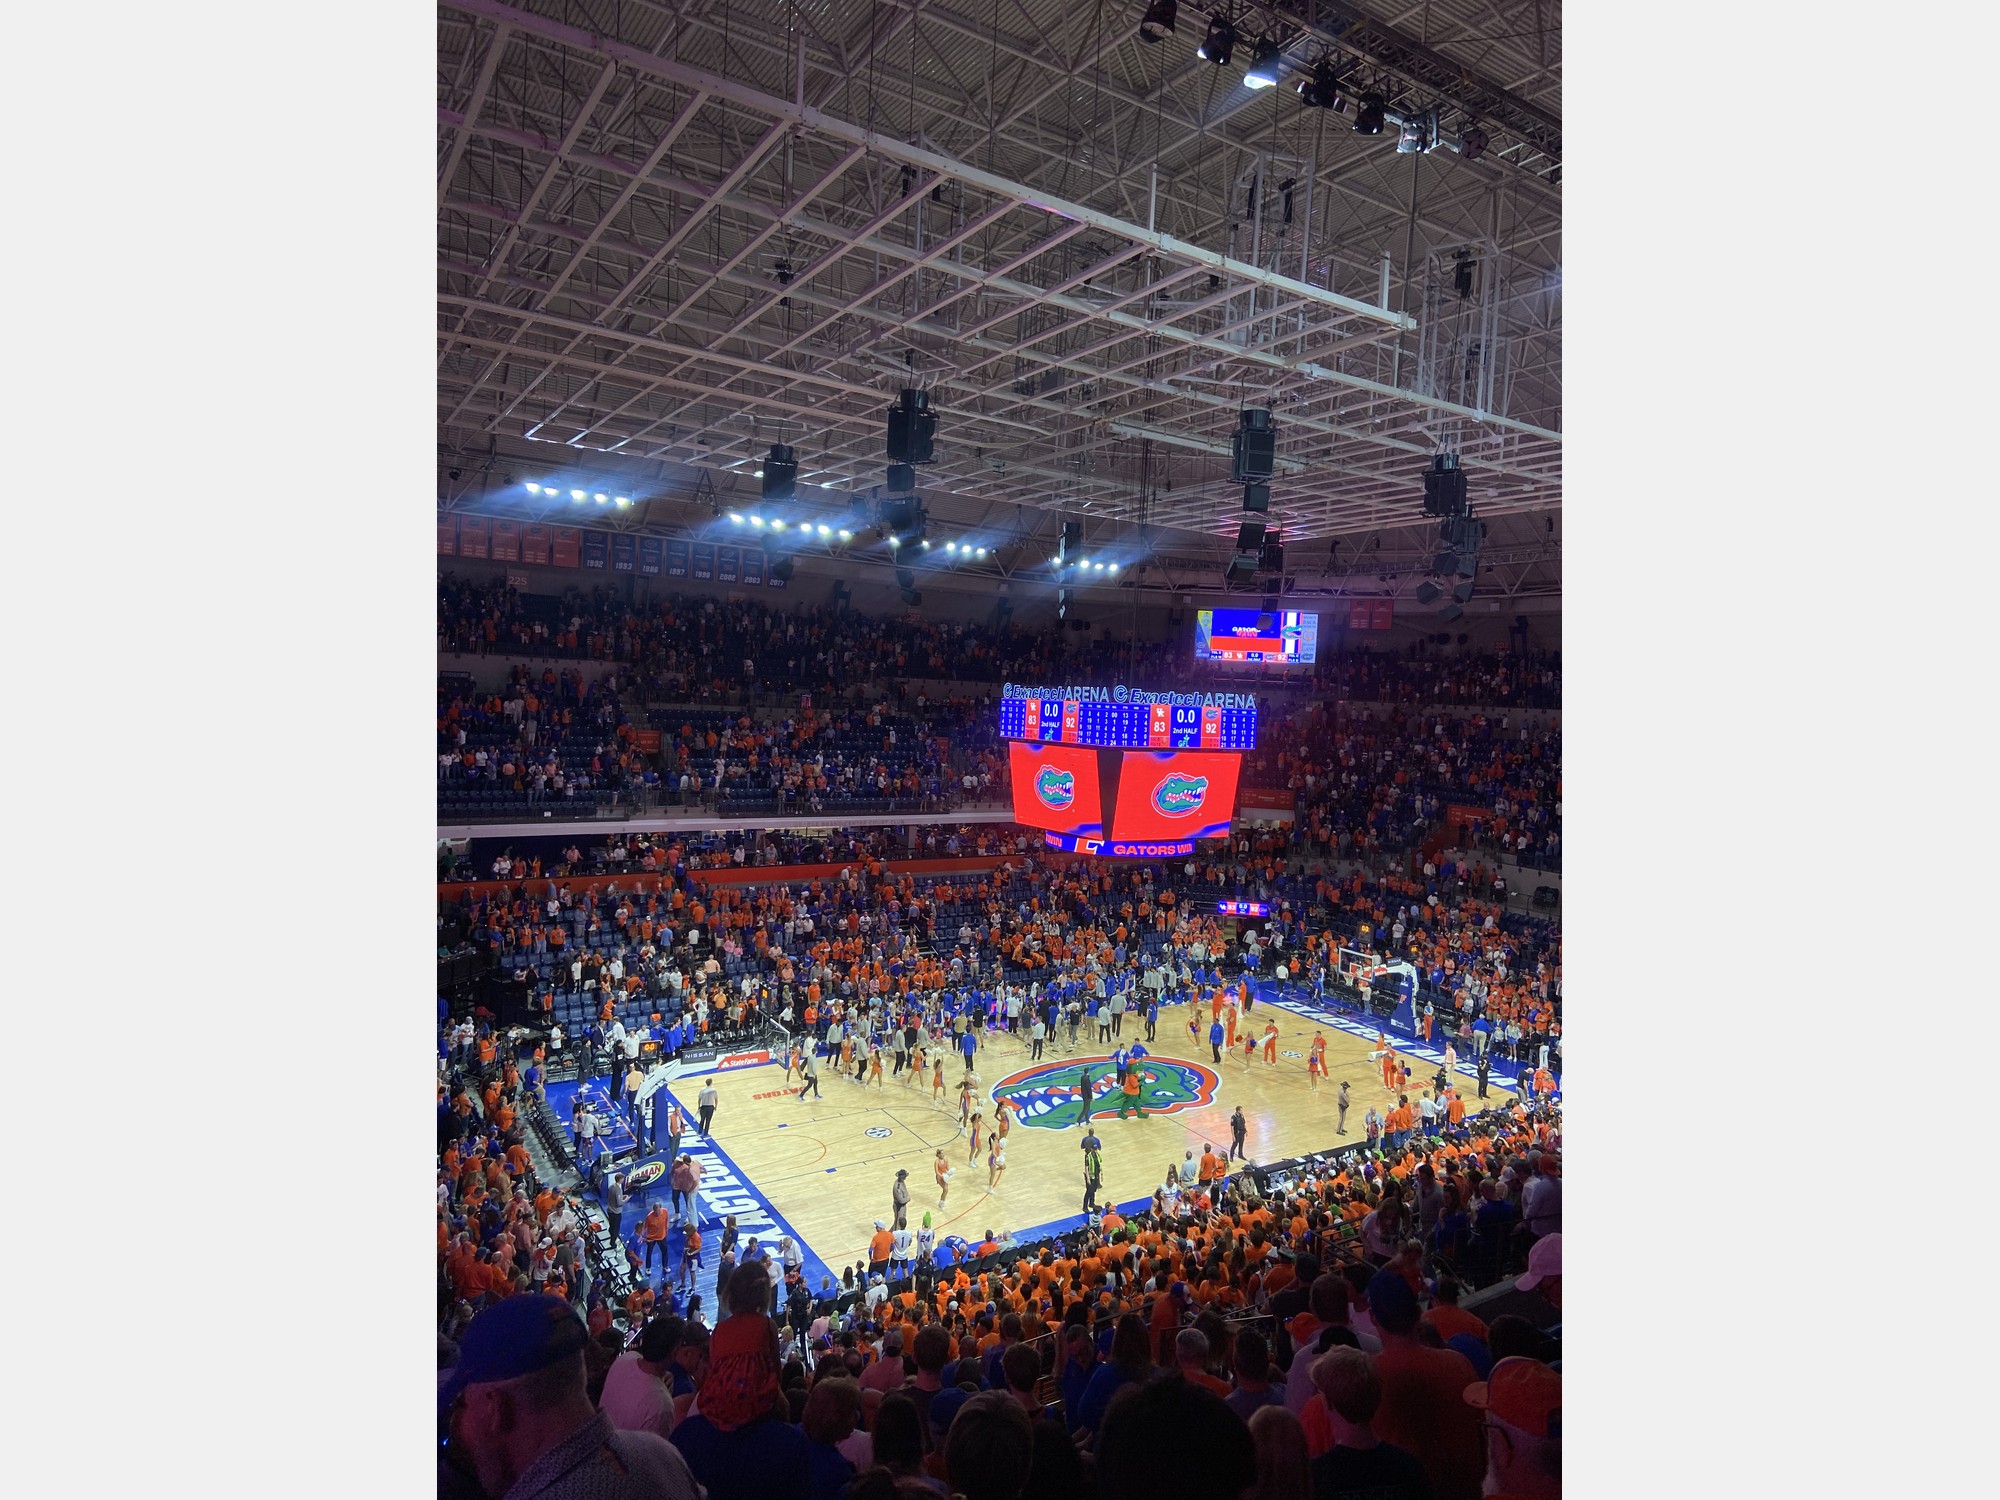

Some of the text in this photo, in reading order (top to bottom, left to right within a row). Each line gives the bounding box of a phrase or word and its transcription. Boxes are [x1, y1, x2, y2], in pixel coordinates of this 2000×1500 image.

[670, 568, 685, 576] 1997
[508, 576, 527, 585] 225
[770, 579, 784, 587] 2017
[1129, 688, 1256, 709] Exactech ARENA
[1045, 704, 1058, 717] 0.0
[1028, 715, 1036, 725] 83
[1177, 709, 1195, 723] 0.0
[1066, 717, 1075, 728] 92
[1154, 722, 1165, 732] 83
[1206, 723, 1217, 733] 92
[1114, 845, 1175, 855] GATORS
[901, 1237, 904, 1248] 1
[920, 1234, 930, 1243] 24
